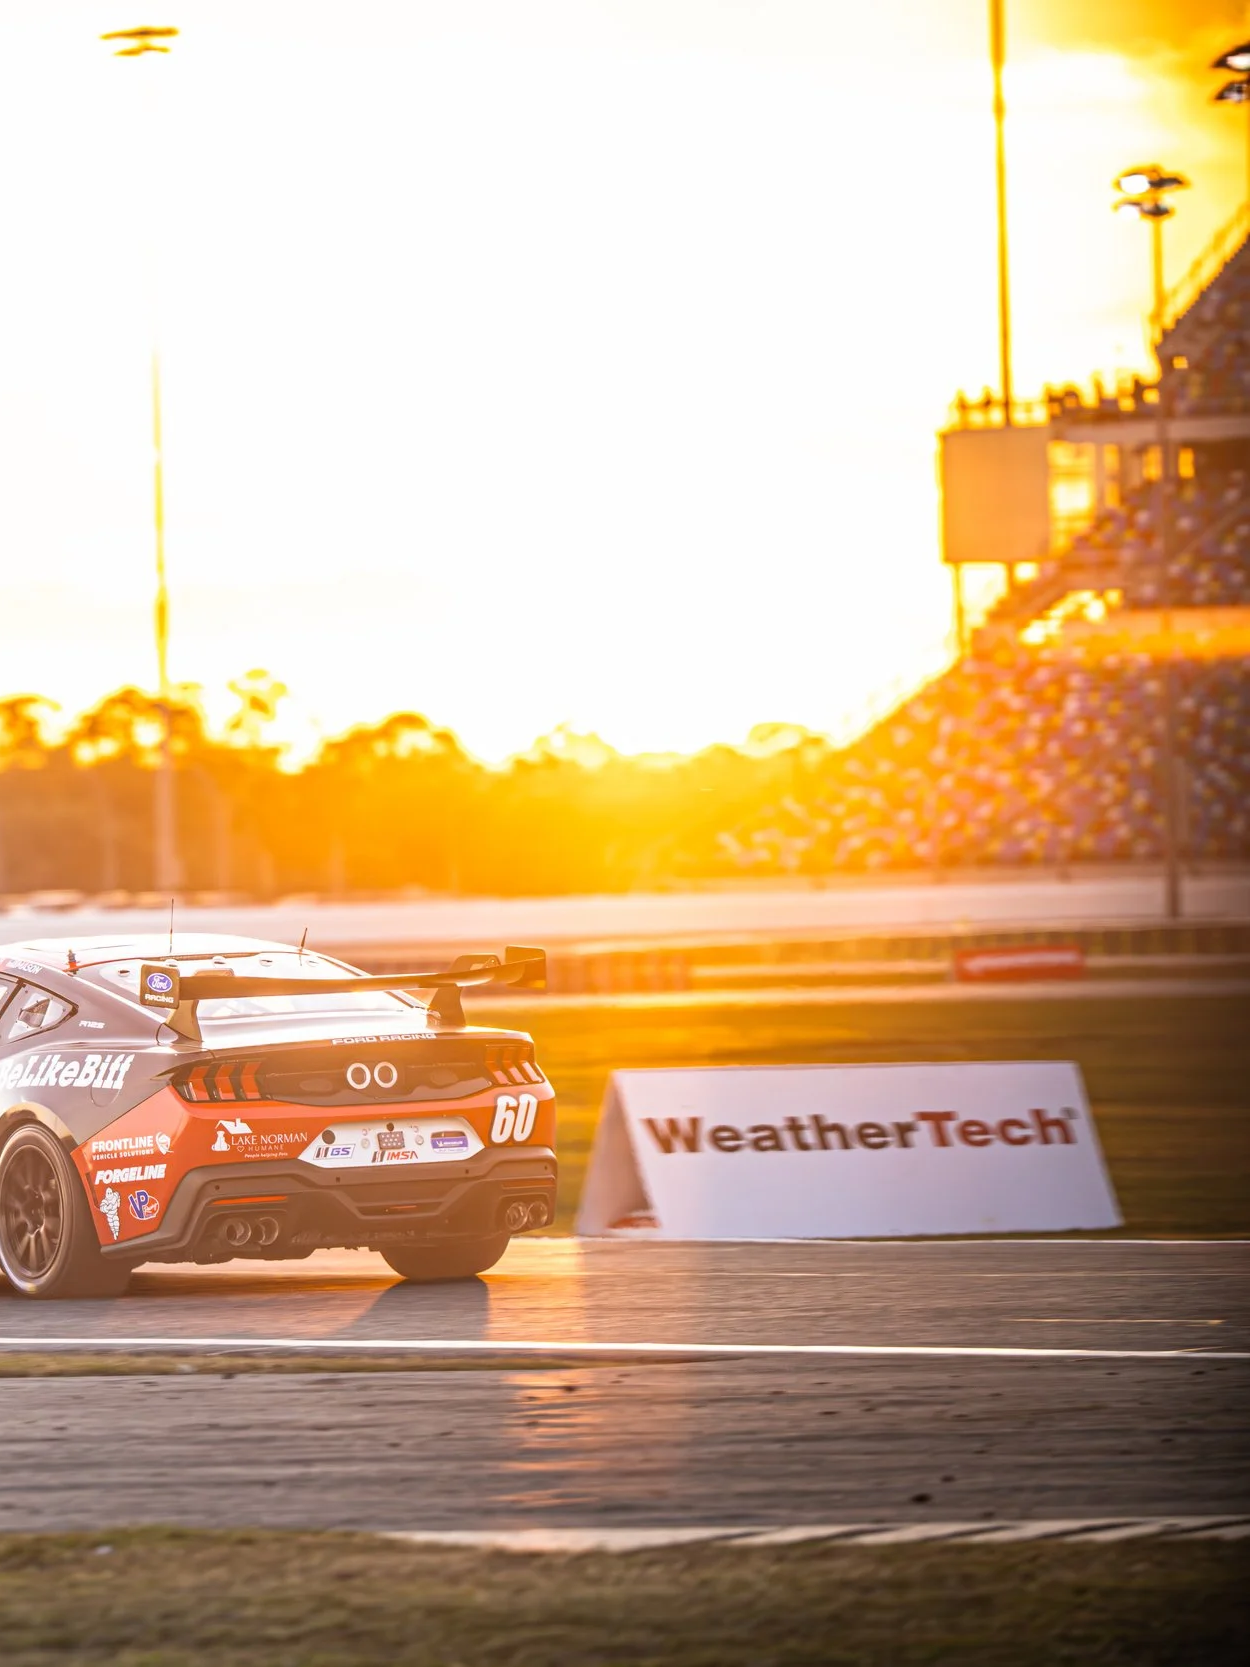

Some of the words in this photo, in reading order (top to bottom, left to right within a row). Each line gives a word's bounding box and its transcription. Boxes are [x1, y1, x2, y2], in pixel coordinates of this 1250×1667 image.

[145, 994, 174, 1003] RACING
[332, 1036, 377, 1045] FORD
[379, 1033, 437, 1042] RACING
[491, 1093, 538, 1144] 60
[92, 1135, 154, 1153] FRONTLINE
[231, 1135, 258, 1146] LAKE
[261, 1132, 308, 1144] NORMAN
[248, 1144, 284, 1152] HUMANE
[330, 1146, 351, 1156] GS
[92, 1153, 118, 1161] VEHICLE
[119, 1149, 154, 1158] SOLUTIONS
[386, 1150, 419, 1162] IMSA
[95, 1164, 167, 1185] FORGELINE
[128, 1189, 149, 1219] VP
